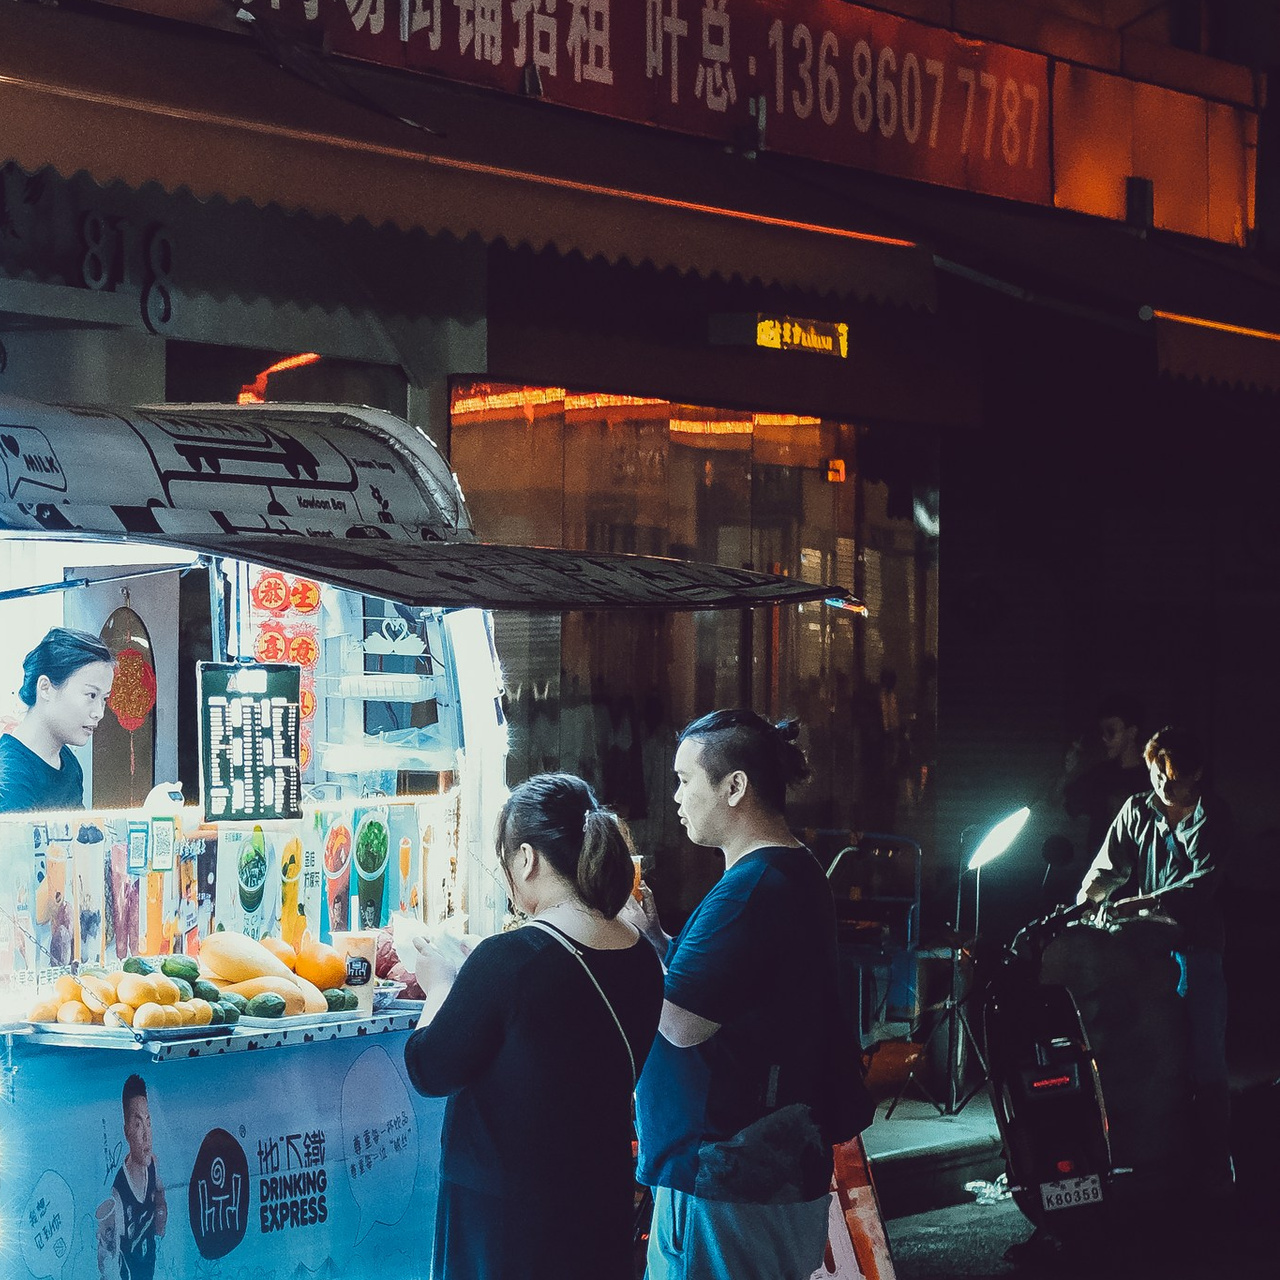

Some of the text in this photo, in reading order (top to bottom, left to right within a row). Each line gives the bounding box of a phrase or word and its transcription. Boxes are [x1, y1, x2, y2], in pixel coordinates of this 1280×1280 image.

[24, 453, 59, 475] MILK
[260, 1169, 327, 1203] DRINKING
[260, 1195, 328, 1234] EXPRESS
